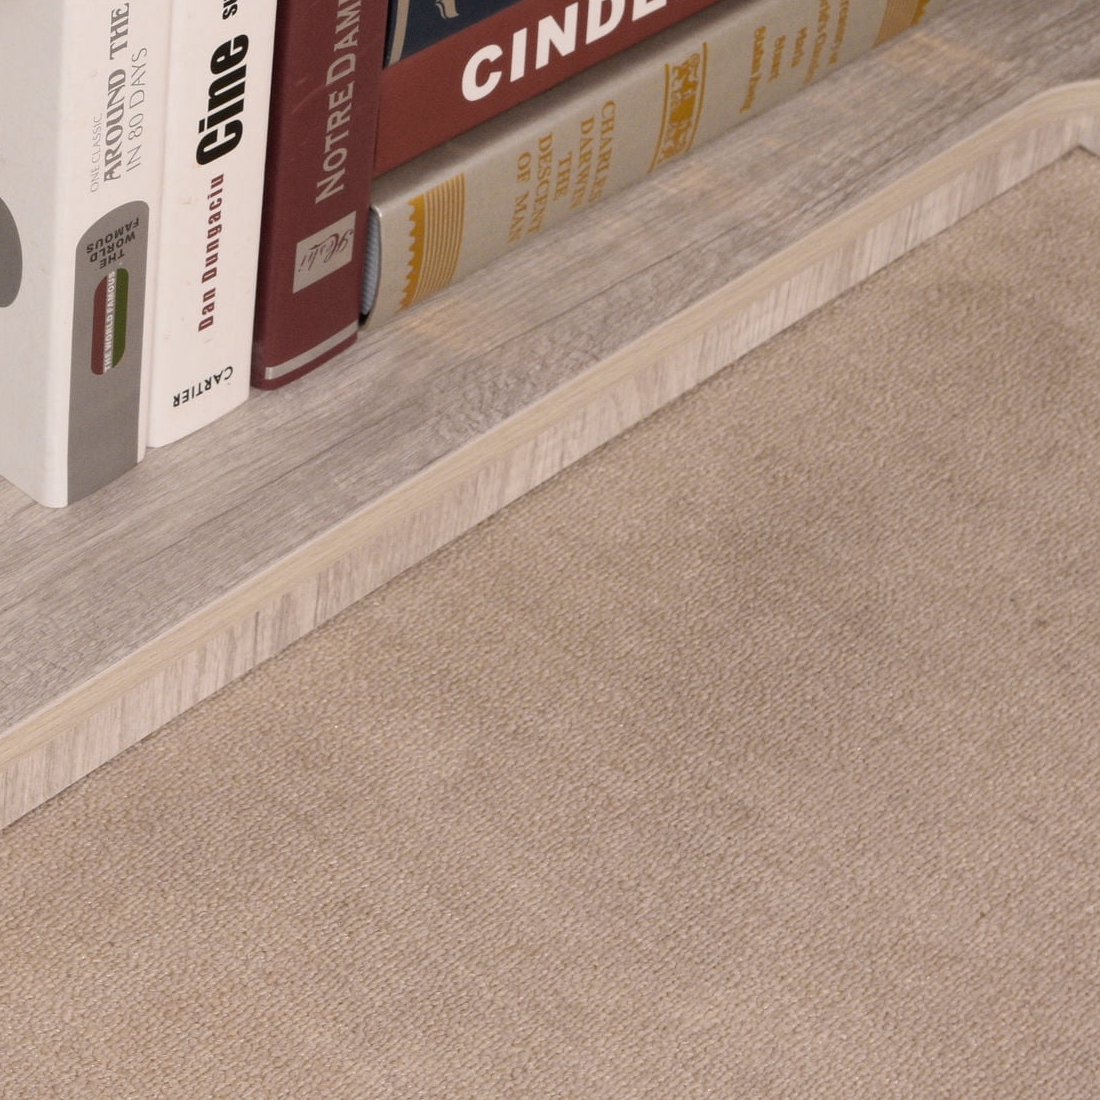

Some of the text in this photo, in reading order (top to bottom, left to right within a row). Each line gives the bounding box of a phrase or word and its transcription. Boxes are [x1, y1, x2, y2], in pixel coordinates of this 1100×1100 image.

[109, 2, 130, 60] THE
[103, 68, 127, 182] AROUND
[126, 47, 148, 173] IN 80 DAYS
[196, 33, 250, 166] Cine
[315, 79, 354, 204] NOTRE
[90, 115, 103, 193] ONE CLASSIC
[506, 152, 532, 244] OF MAN
[526, 132, 553, 235] DESCENT
[554, 150, 573, 201] THE
[569, 116, 595, 210] DARWIN
[588, 100, 616, 202] CHARLES
[86, 217, 140, 254] FAMOUS
[90, 232, 136, 263] WORLD
[100, 248, 126, 269] THE
[198, 173, 225, 332] Dan Dungaciu
[104, 271, 116, 373] THE WORLD FAMOUS
[172, 365, 234, 407] CARTIER
